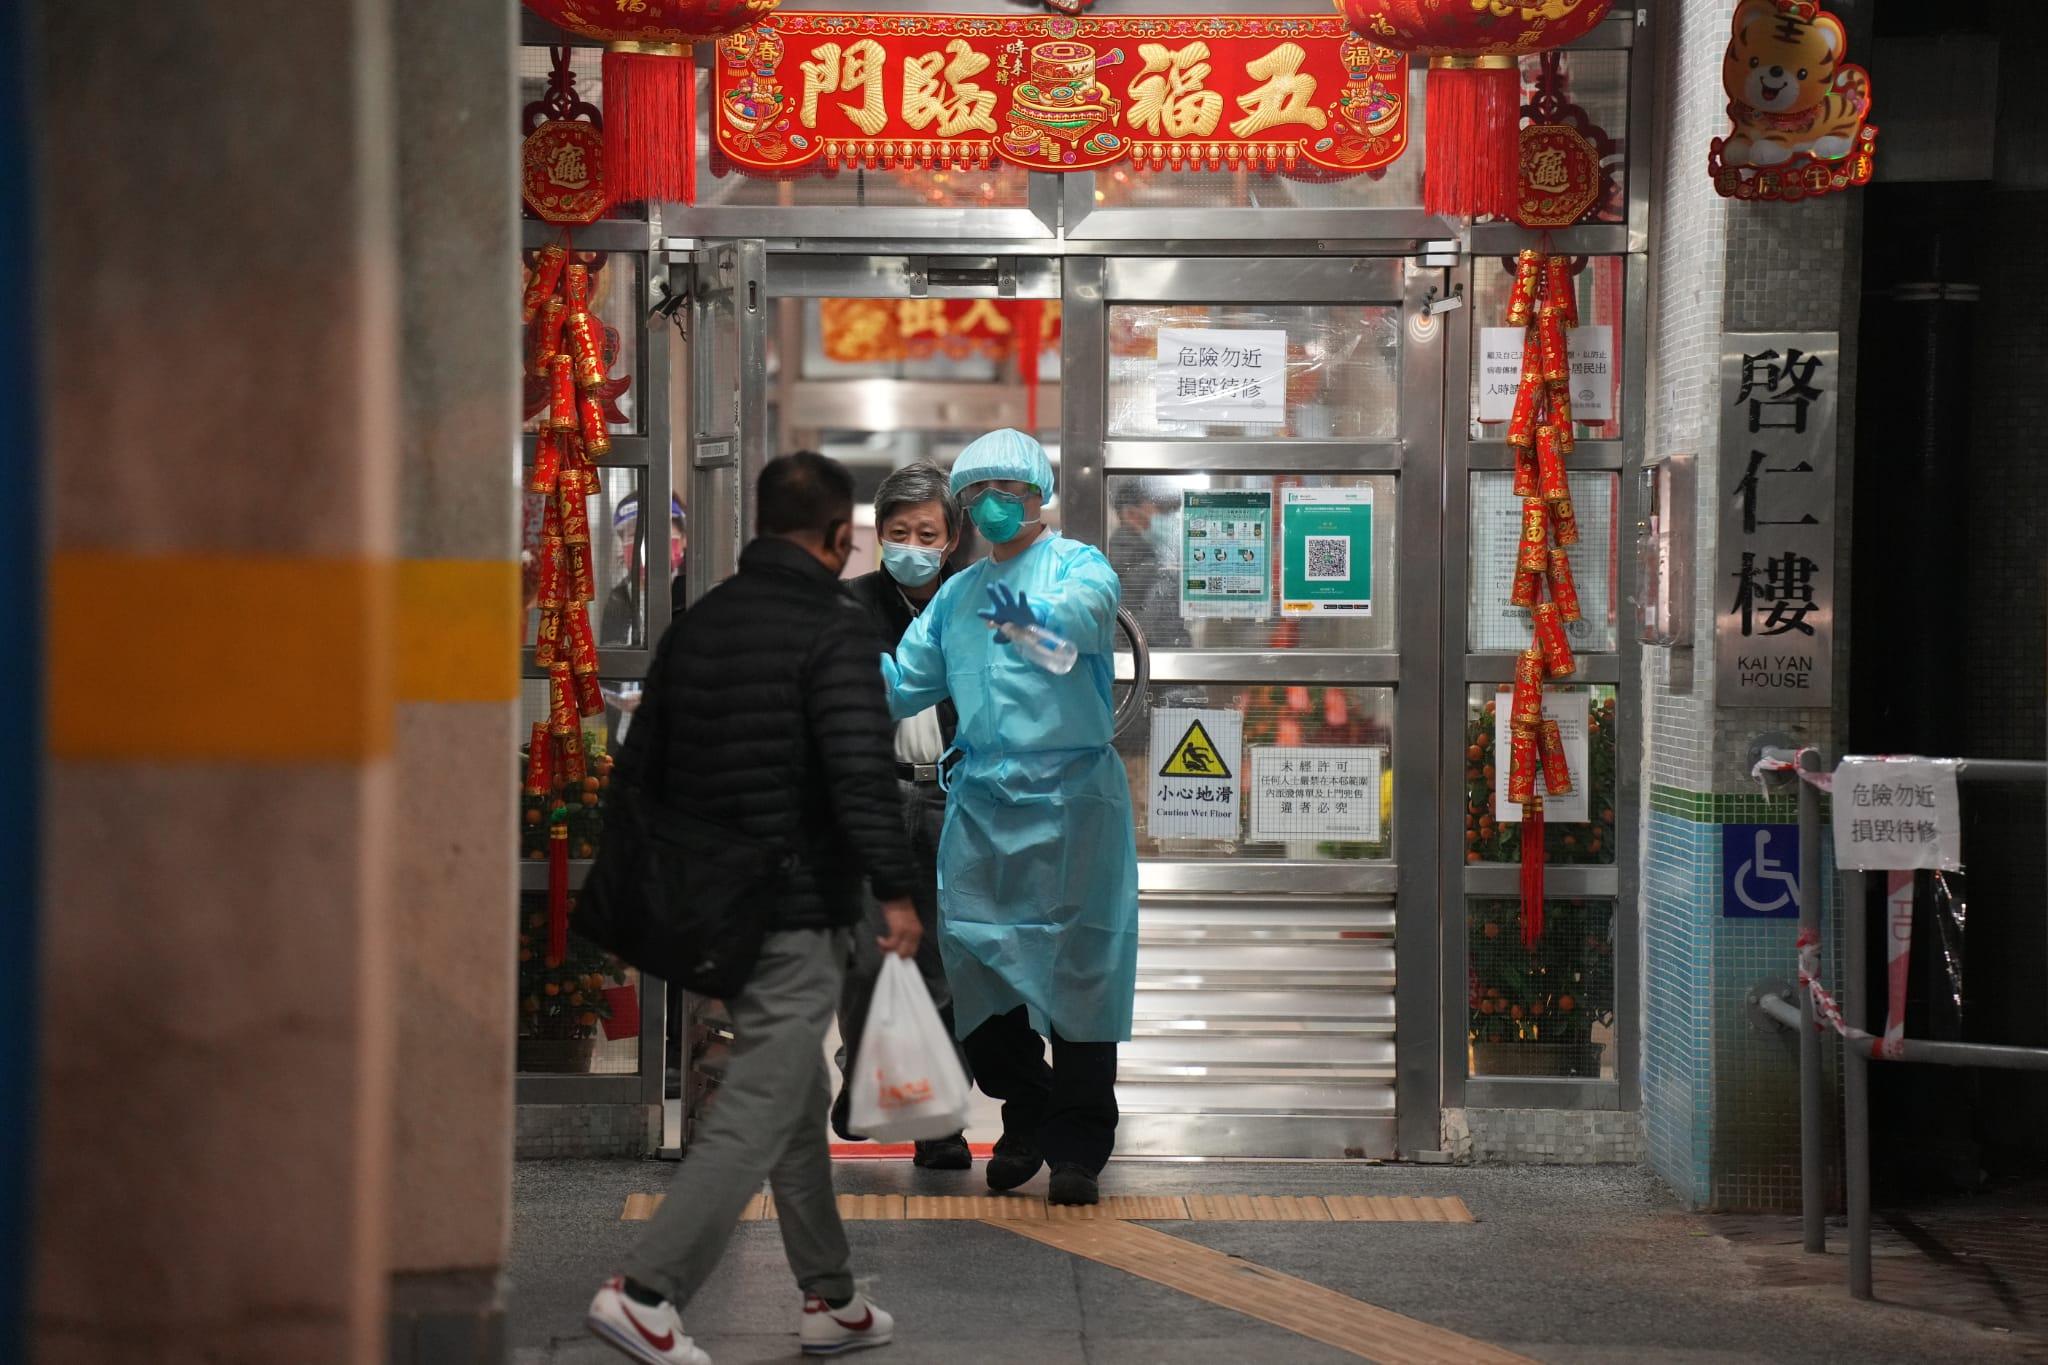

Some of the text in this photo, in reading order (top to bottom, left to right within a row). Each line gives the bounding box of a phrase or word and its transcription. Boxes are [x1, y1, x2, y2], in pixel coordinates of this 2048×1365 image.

[1177, 347, 1262, 368] 危險勿近
[1738, 656, 1812, 670] KAI YAN
[1742, 672, 1810, 688] HOUSE
[1281, 760, 1348, 773] 未經許可
[1157, 784, 1234, 804] 小心地滑
[1852, 783, 1936, 808] 危險勿近
[1156, 808, 1232, 818] Caution Wet Floor
[1281, 801, 1348, 814] 違者必究
[1851, 818, 1938, 844] 損毀待修
